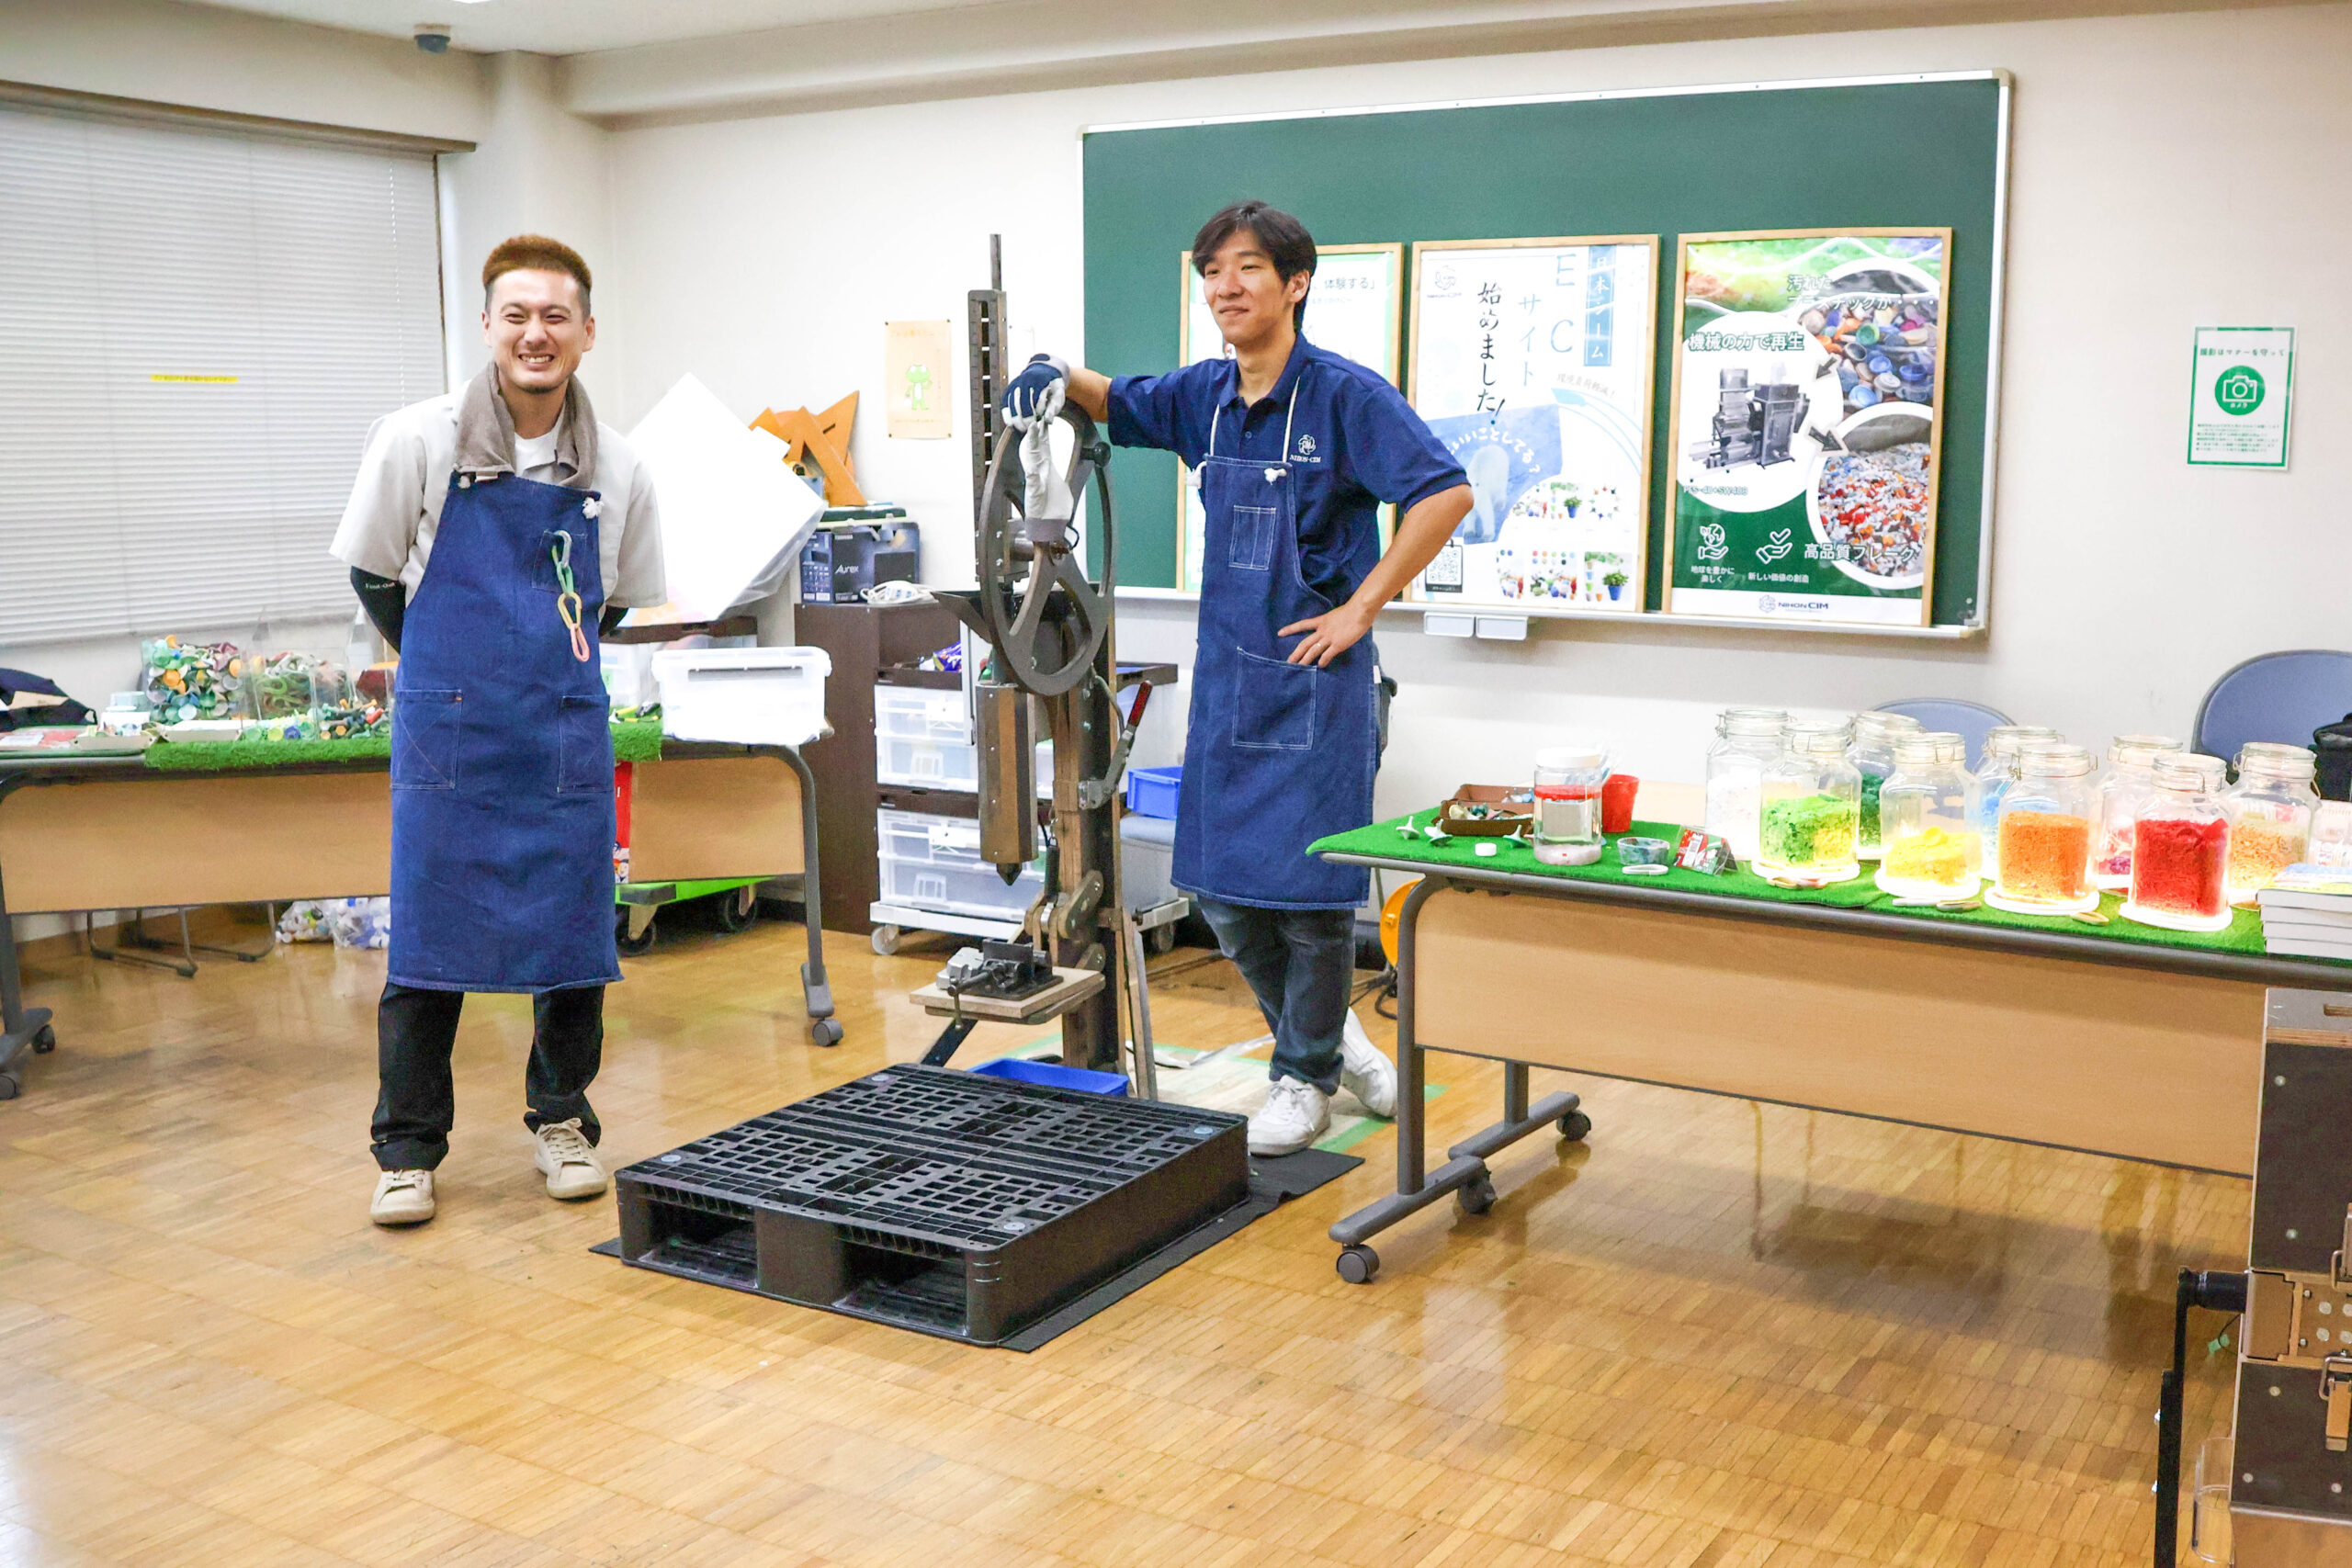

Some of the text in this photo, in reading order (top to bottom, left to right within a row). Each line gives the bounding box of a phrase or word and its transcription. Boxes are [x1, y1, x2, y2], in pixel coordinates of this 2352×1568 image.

[1786, 275, 1834, 291] 汚れた
[1591, 256, 1610, 358] 日本シーム
[1689, 331, 1805, 351] 機械の力で再生
[1804, 543, 1916, 563] 高品質フレーク
[1807, 602, 1829, 610] CIM
